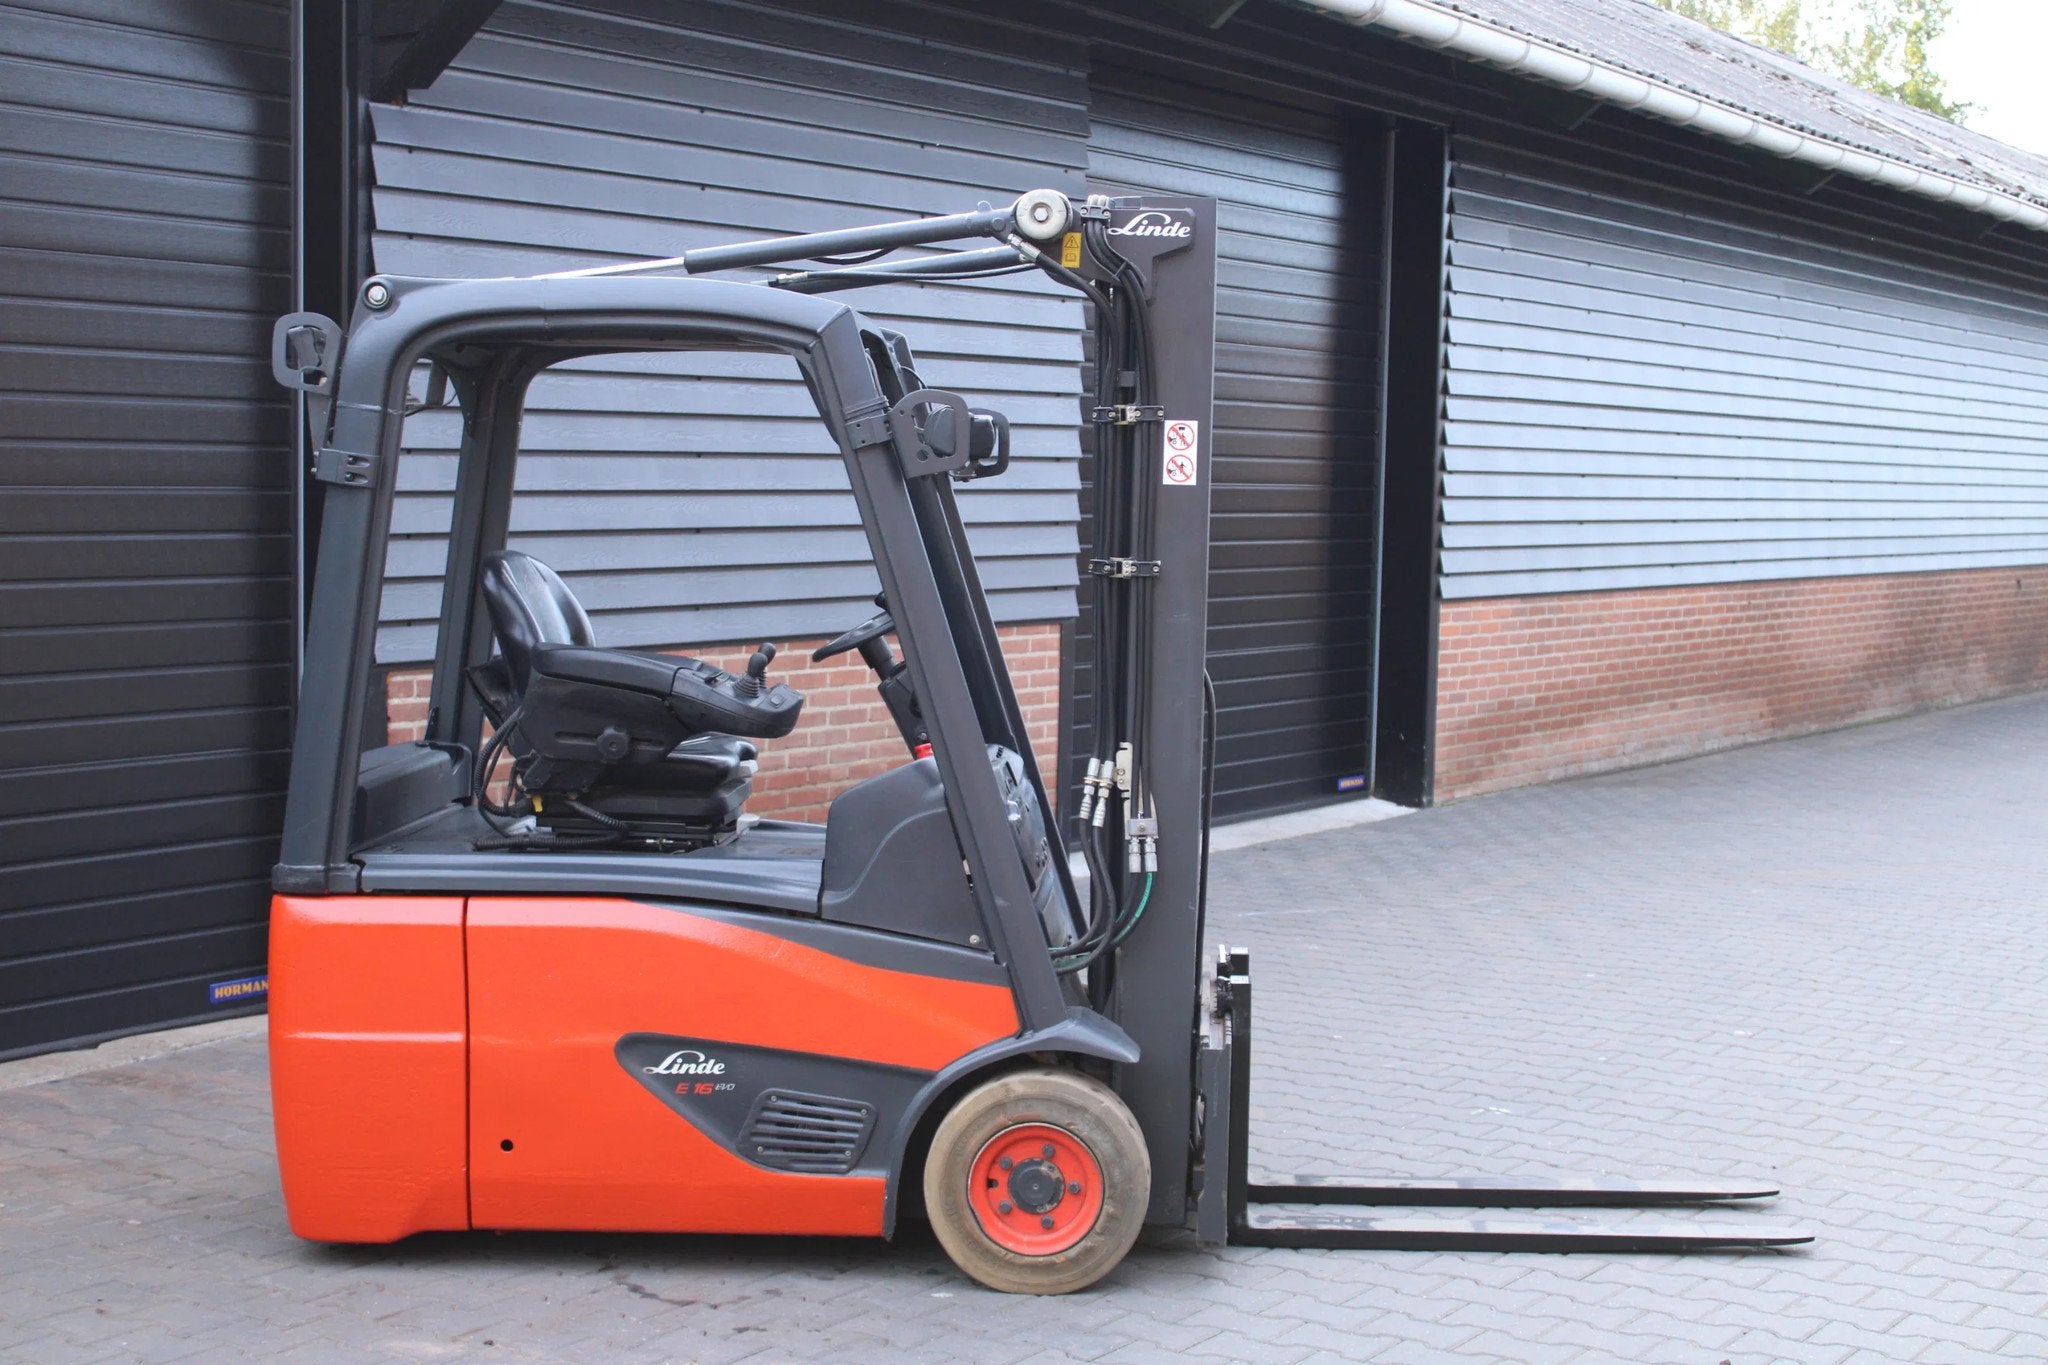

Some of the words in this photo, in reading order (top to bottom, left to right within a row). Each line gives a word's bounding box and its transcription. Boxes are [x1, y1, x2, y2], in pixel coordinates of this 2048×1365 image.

[1107, 211, 1191, 238] Linde
[642, 1050, 726, 1075] Linde
[675, 1082, 690, 1095] E
[694, 1082, 715, 1095] 16
